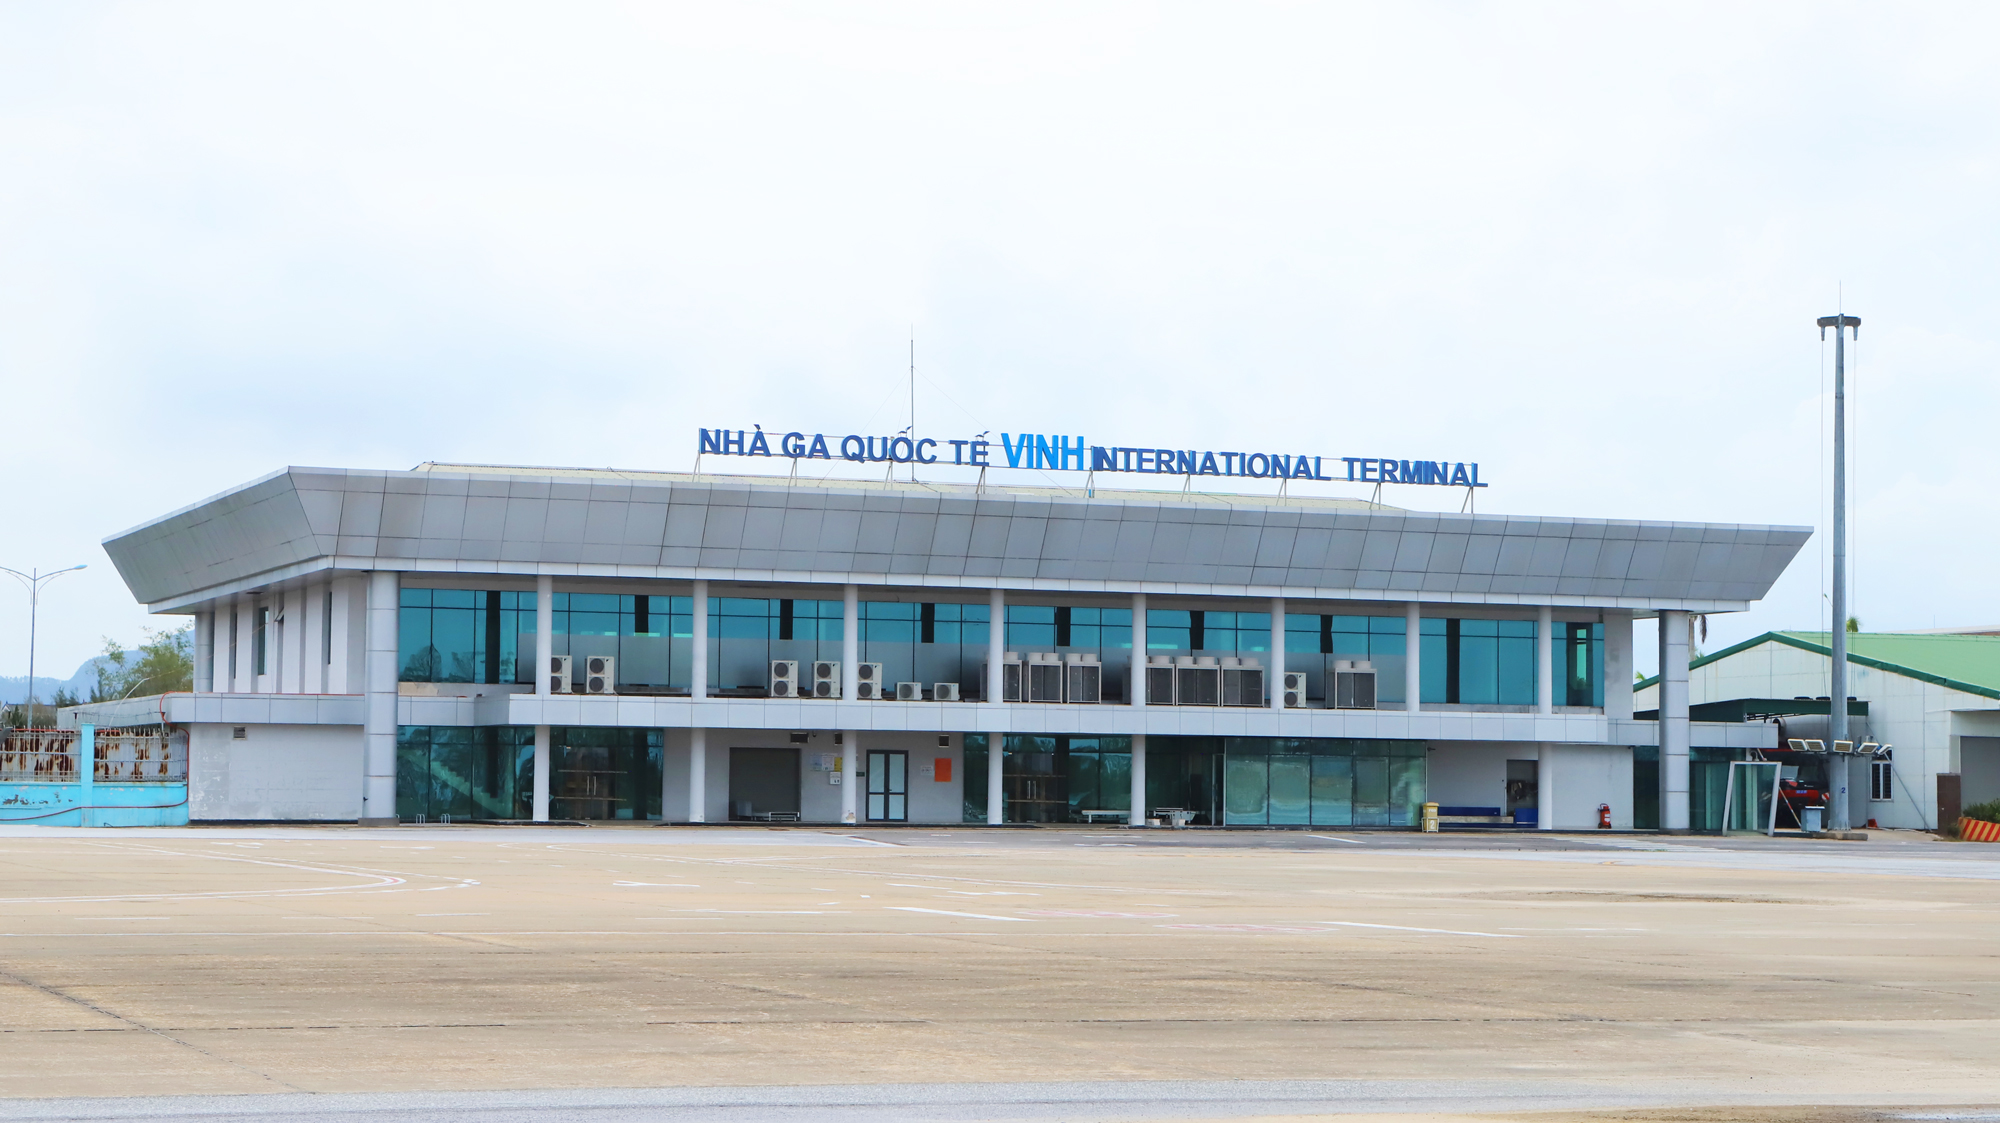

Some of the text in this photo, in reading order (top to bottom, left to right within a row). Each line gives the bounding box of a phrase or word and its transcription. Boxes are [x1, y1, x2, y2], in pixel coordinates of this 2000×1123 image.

[700, 424, 1488, 487] NHÀ GA QUỐC TẾ VINH INTERNATIONAL TERMINAL
[1430, 820, 1435, 830] 2
